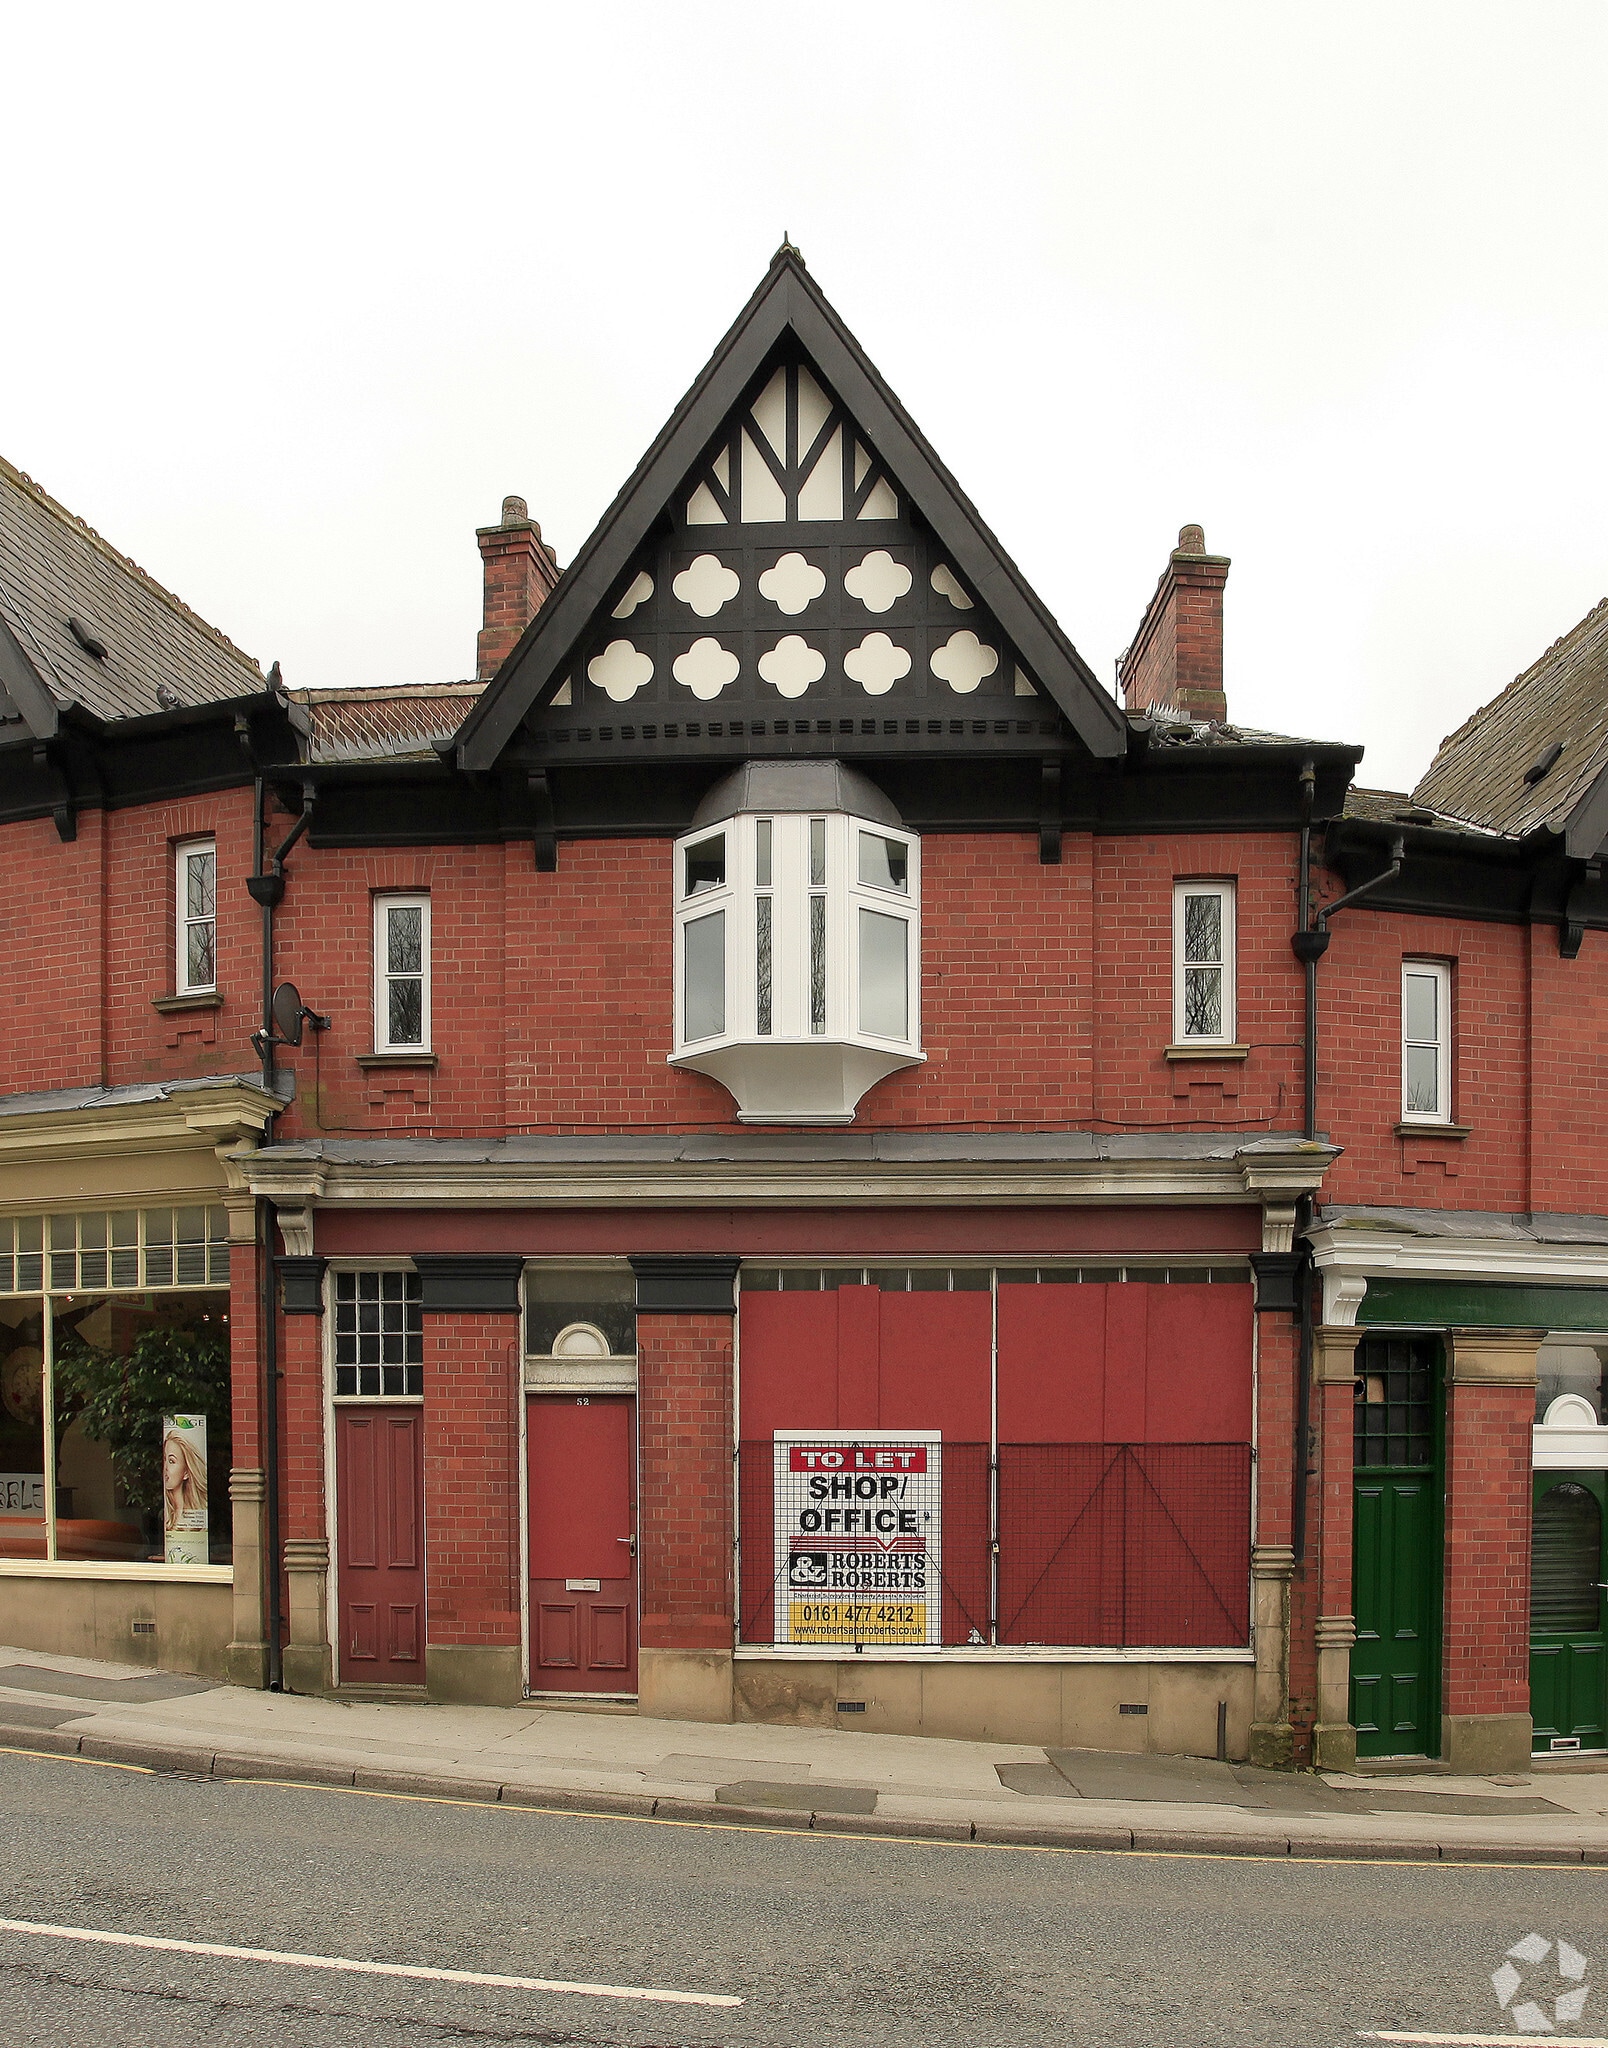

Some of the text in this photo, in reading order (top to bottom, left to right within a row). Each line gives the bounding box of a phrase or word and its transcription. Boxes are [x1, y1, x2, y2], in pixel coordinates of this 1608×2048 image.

[576, 1397, 590, 1406] 52
[801, 1451, 916, 1468] TO LET
[809, 1476, 908, 1500] SHOP/
[800, 1508, 917, 1533] OFFICE
[790, 1553, 926, 1584] & ROBERTS
[832, 1571, 926, 1588] ROBERTS
[803, 1605, 914, 1622] 0161 477 4212
[794, 1624, 923, 1635] www.robertsandroberts.co.uk
